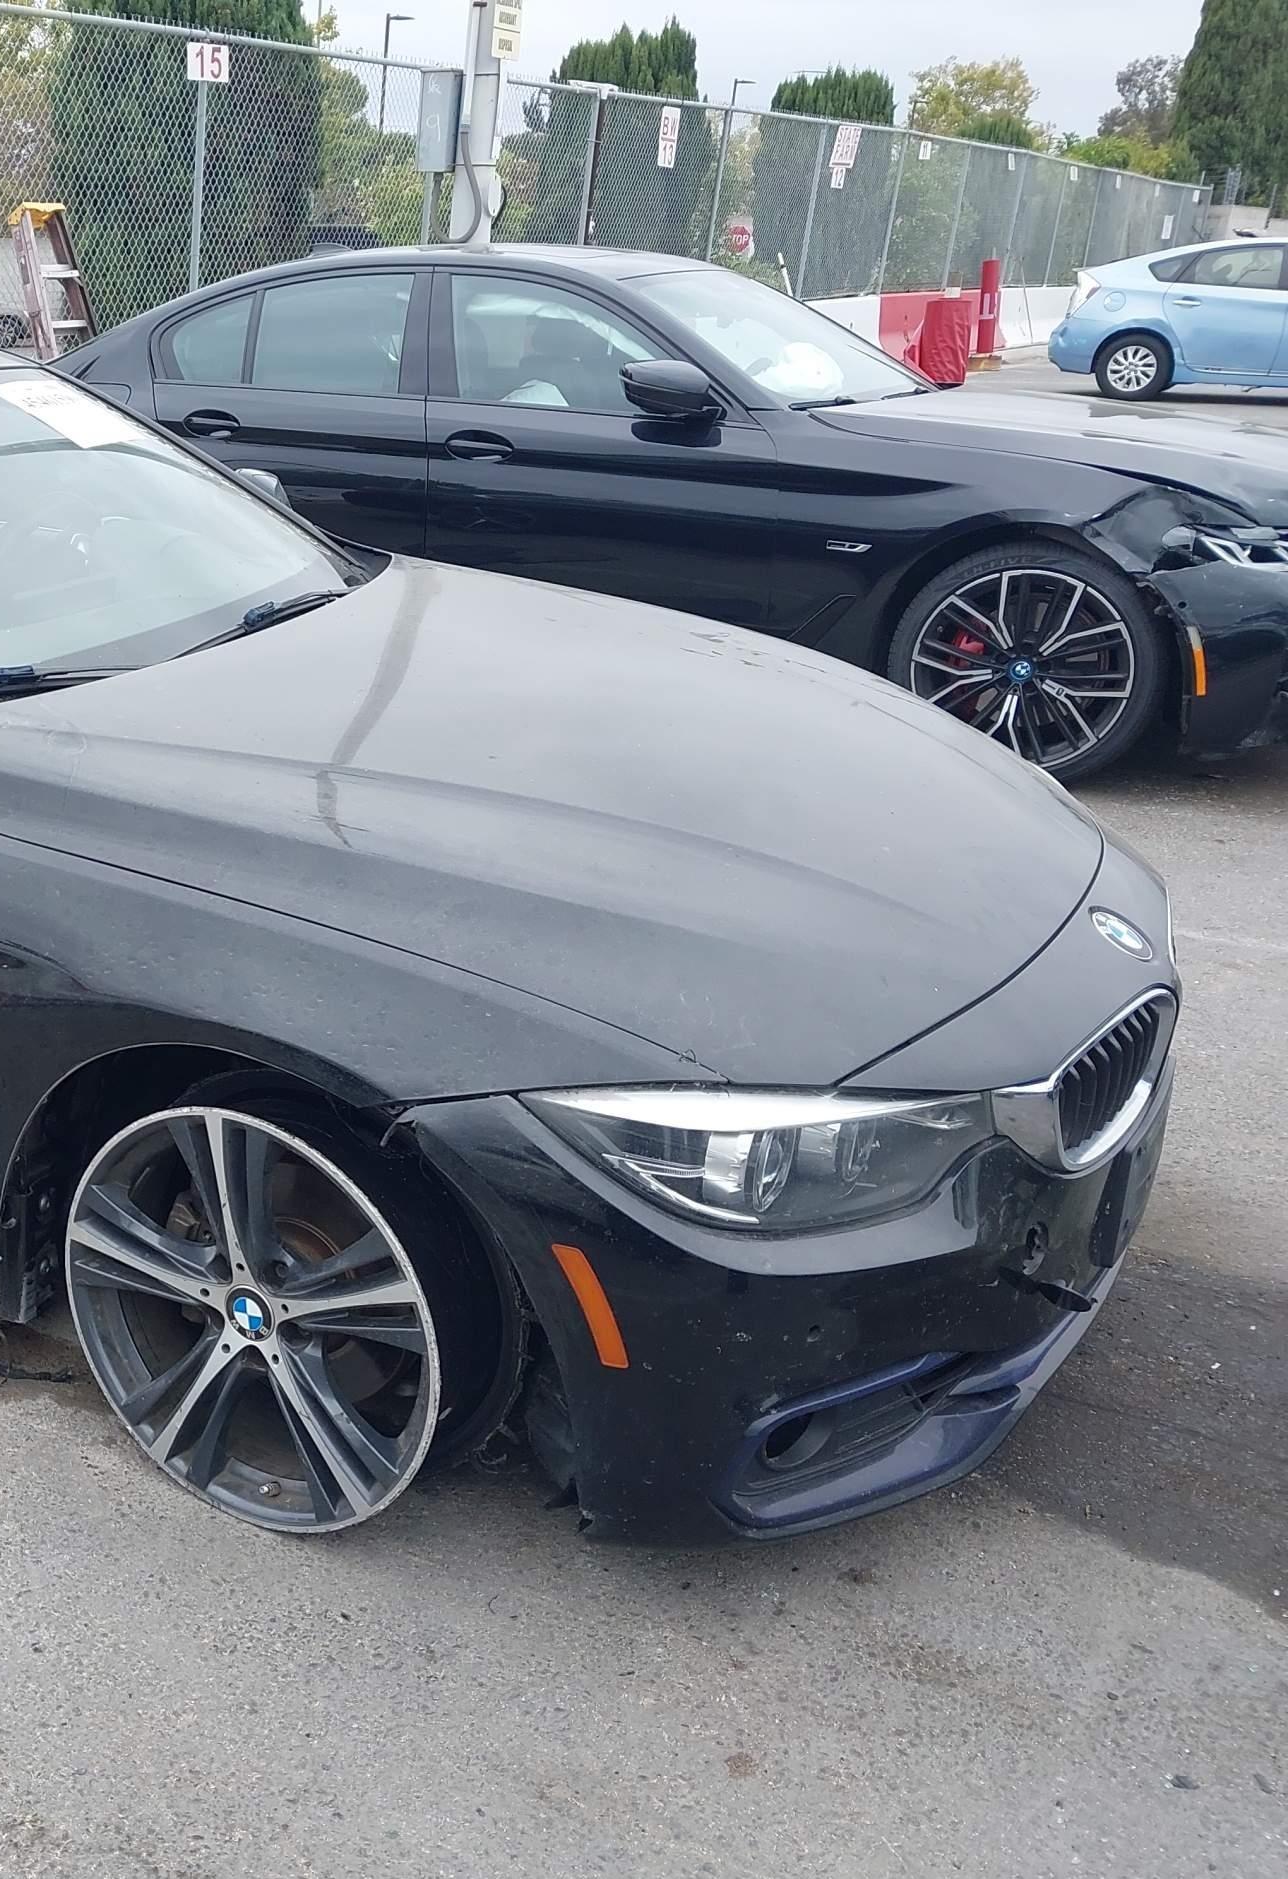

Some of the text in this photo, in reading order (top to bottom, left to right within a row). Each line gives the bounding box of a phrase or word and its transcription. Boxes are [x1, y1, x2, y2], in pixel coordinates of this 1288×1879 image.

[195, 44, 223, 79] 15
[837, 126, 861, 145] STATE
[662, 143, 674, 166] 13
[833, 168, 845, 188] 12
[730, 234, 749, 245] TOP
